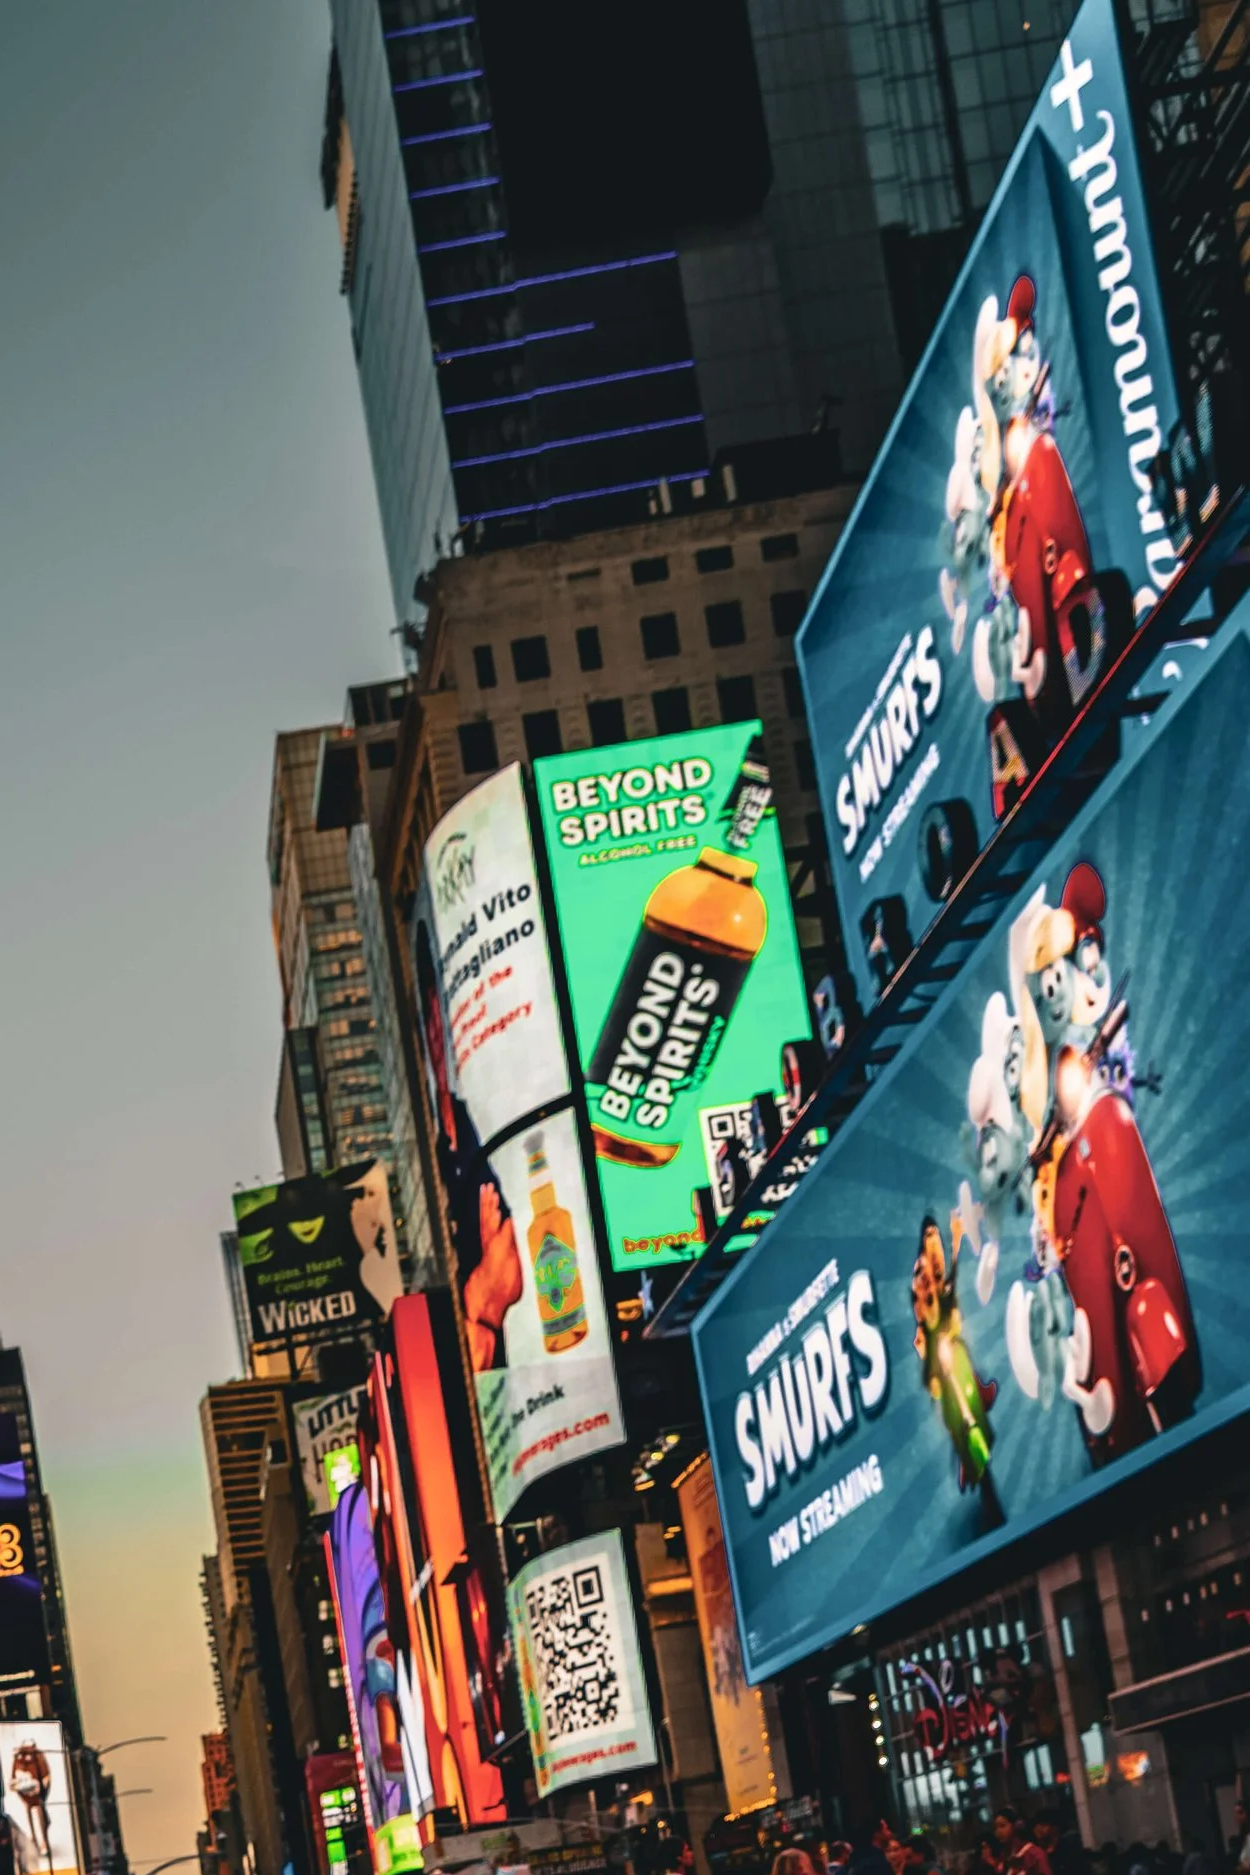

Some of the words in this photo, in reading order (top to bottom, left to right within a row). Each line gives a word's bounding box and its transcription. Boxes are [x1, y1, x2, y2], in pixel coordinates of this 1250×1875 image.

[836, 624, 941, 855] SMURFS
[552, 758, 712, 813] BEYOND
[559, 795, 707, 846] SPIRITS
[579, 844, 651, 866] ALCOHOL
[656, 834, 697, 851] FREE
[481, 884, 531, 922] Vito
[599, 951, 686, 1121] BEYOND
[635, 976, 721, 1130] SPIRITS
[526, 1384, 565, 1413] Drink
[735, 1269, 888, 1508] SMURFS
[768, 1515, 801, 1569] NOW
[799, 1453, 884, 1546] STREAMING
